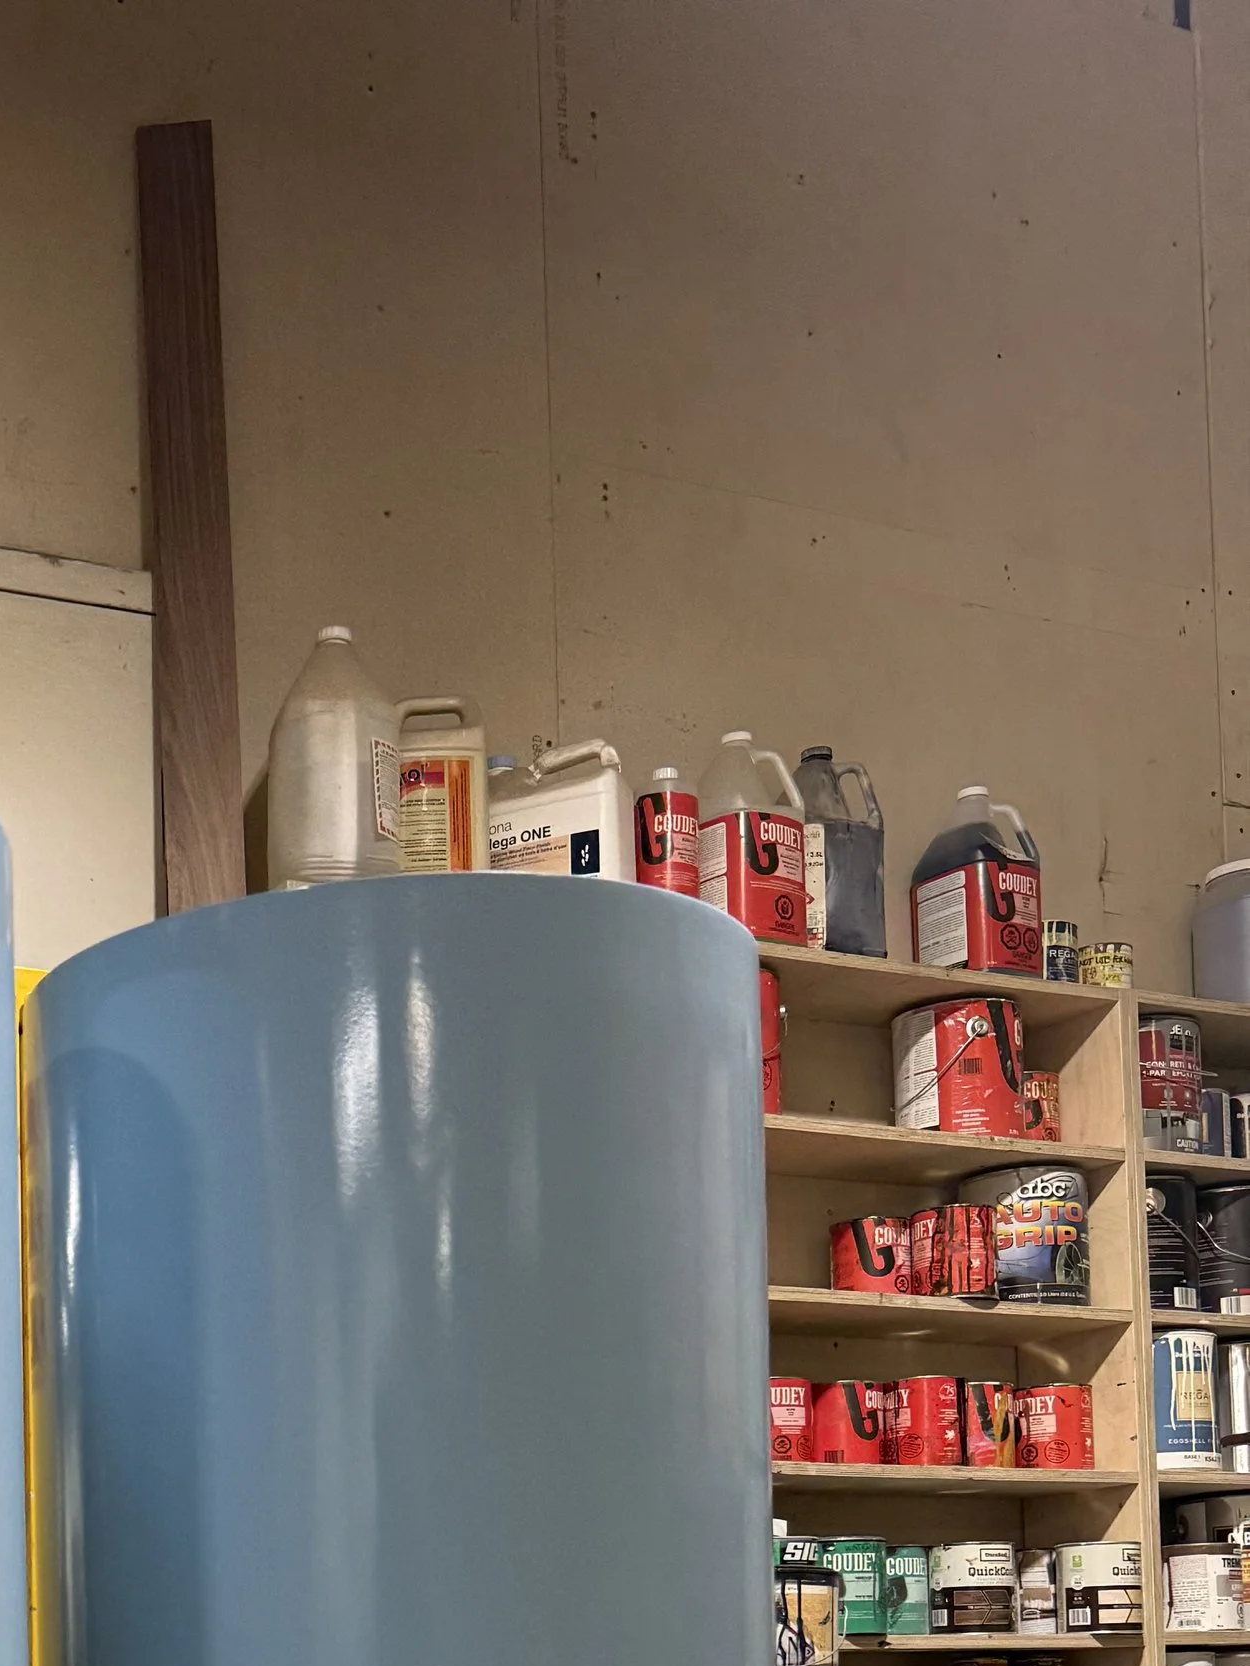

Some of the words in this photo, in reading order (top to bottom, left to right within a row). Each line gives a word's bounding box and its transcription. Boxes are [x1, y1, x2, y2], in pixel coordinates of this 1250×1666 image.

[489, 836, 516, 850] ega
[521, 826, 551, 842] ONE
[760, 821, 801, 850] GOUDEY
[999, 871, 1037, 897] GOUDEY
[1016, 1179, 1066, 1198] abc
[996, 1200, 1083, 1225] AUTO
[997, 1225, 1077, 1250] GRIP
